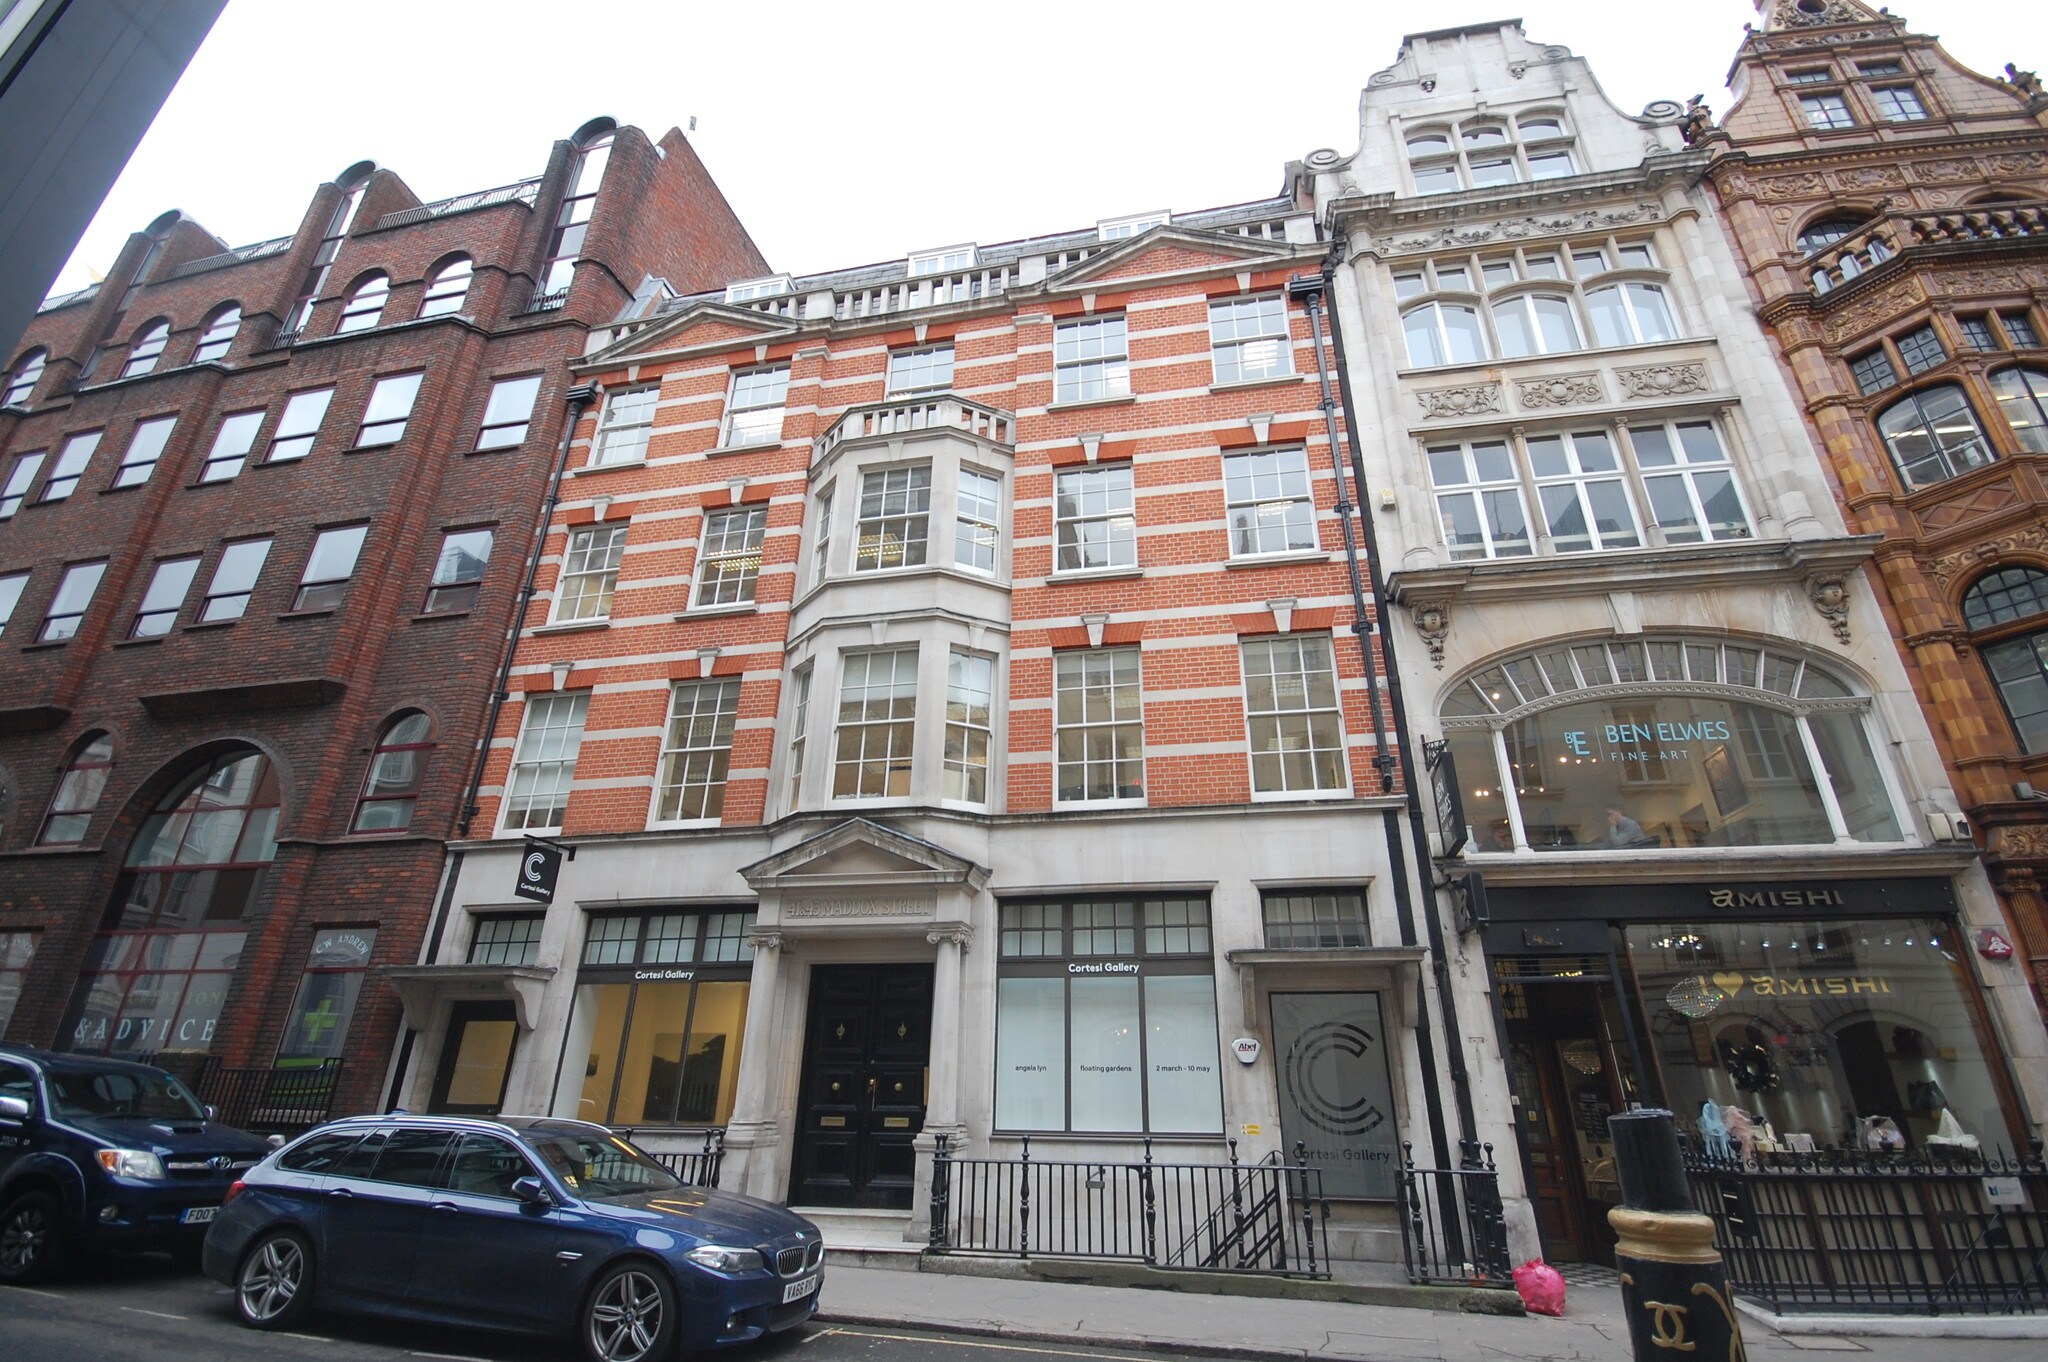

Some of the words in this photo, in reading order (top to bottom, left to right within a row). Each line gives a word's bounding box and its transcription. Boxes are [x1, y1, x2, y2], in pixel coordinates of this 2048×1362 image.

[1605, 724, 1651, 743] BEN
[1657, 721, 1730, 741] ELWES
[1611, 752, 1649, 761] FINE
[1659, 750, 1688, 761] ART
[520, 882, 536, 891] Cortesi
[535, 886, 550, 896] Gallery
[823, 899, 878, 917] MADDOX
[882, 898, 928, 916] STREET
[337, 934, 369, 955] ANDREW
[1068, 963, 1103, 973] Cortesi
[1104, 963, 1139, 974] Gallery
[635, 970, 664, 980] Cortesi
[664, 970, 694, 981] Gallery
[93, 1018, 217, 1042] ADVICE
[1015, 1065, 1037, 1073] angela
[1080, 1065, 1105, 1073] floating
[1105, 1065, 1132, 1073] gardens
[1196, 1065, 1211, 1074] may
[1292, 1149, 1339, 1162] Cortesi
[1342, 1148, 1390, 1164] Gallery
